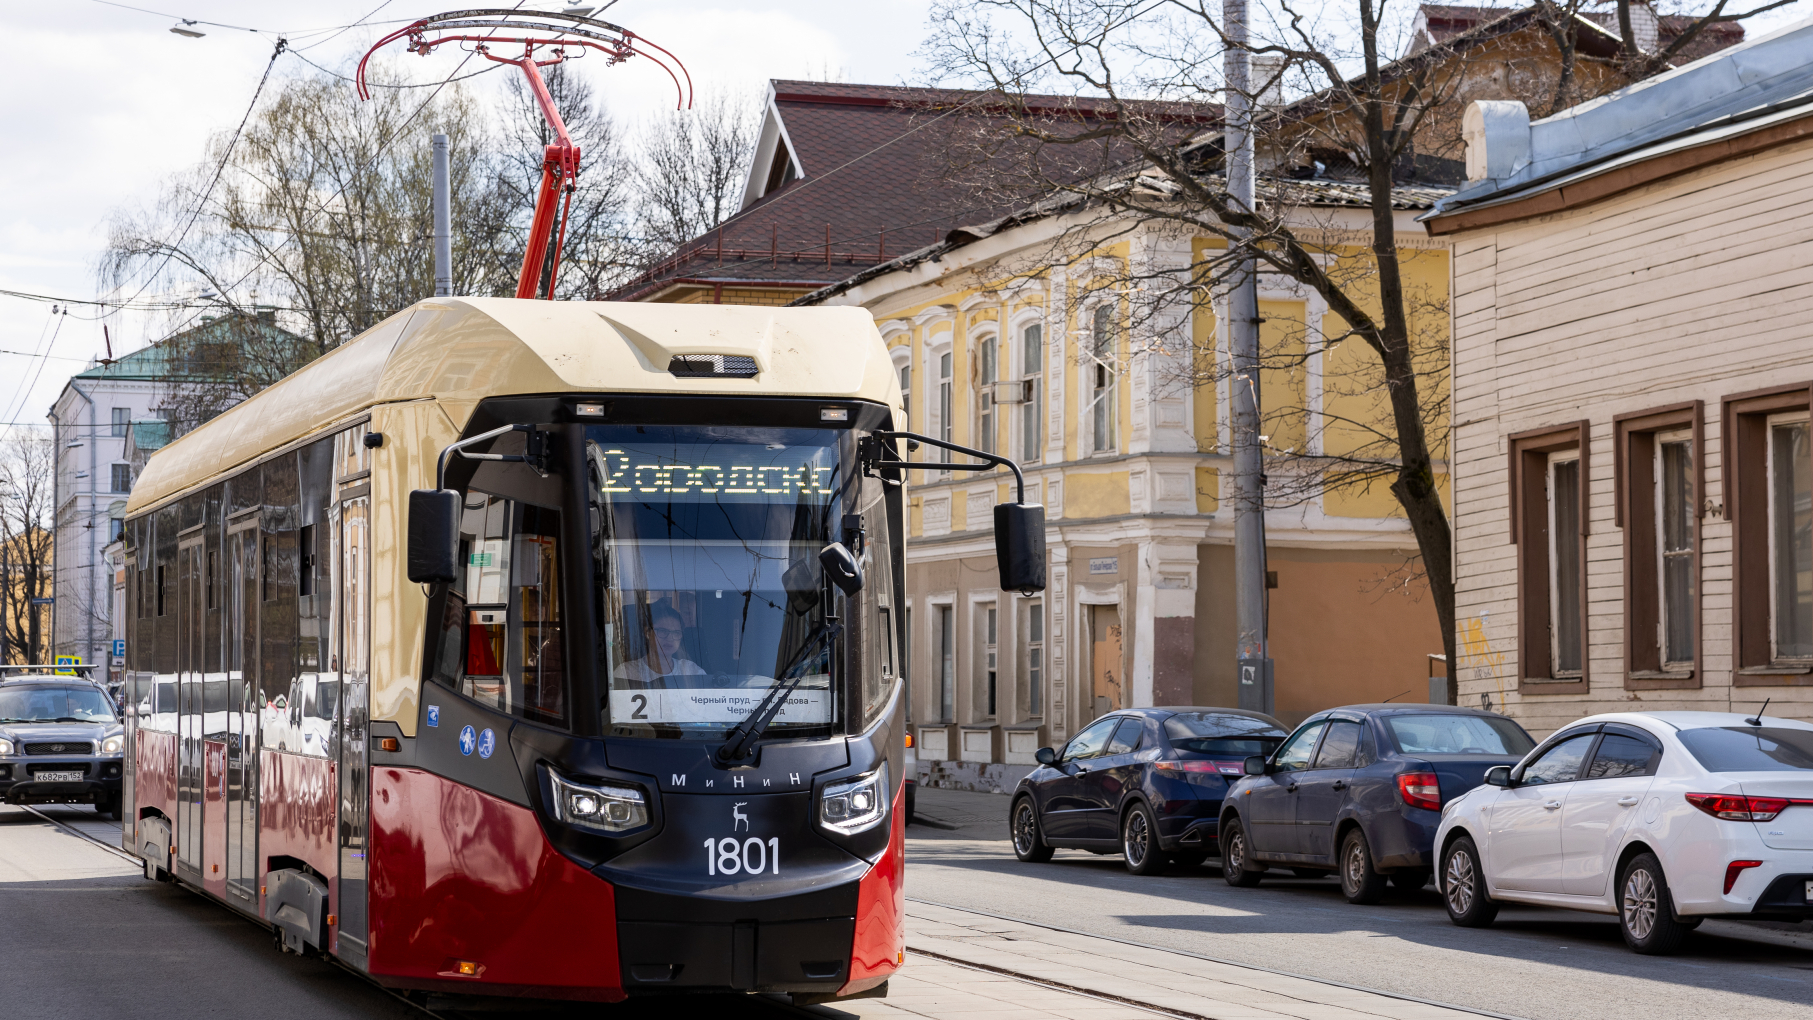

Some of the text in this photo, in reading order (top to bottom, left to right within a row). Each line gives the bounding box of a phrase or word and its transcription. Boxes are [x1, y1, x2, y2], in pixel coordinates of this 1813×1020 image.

[631, 693, 648, 719] 2
[690, 695, 727, 704] Черный
[727, 706, 758, 715] Черны
[703, 837, 779, 876] 1801
